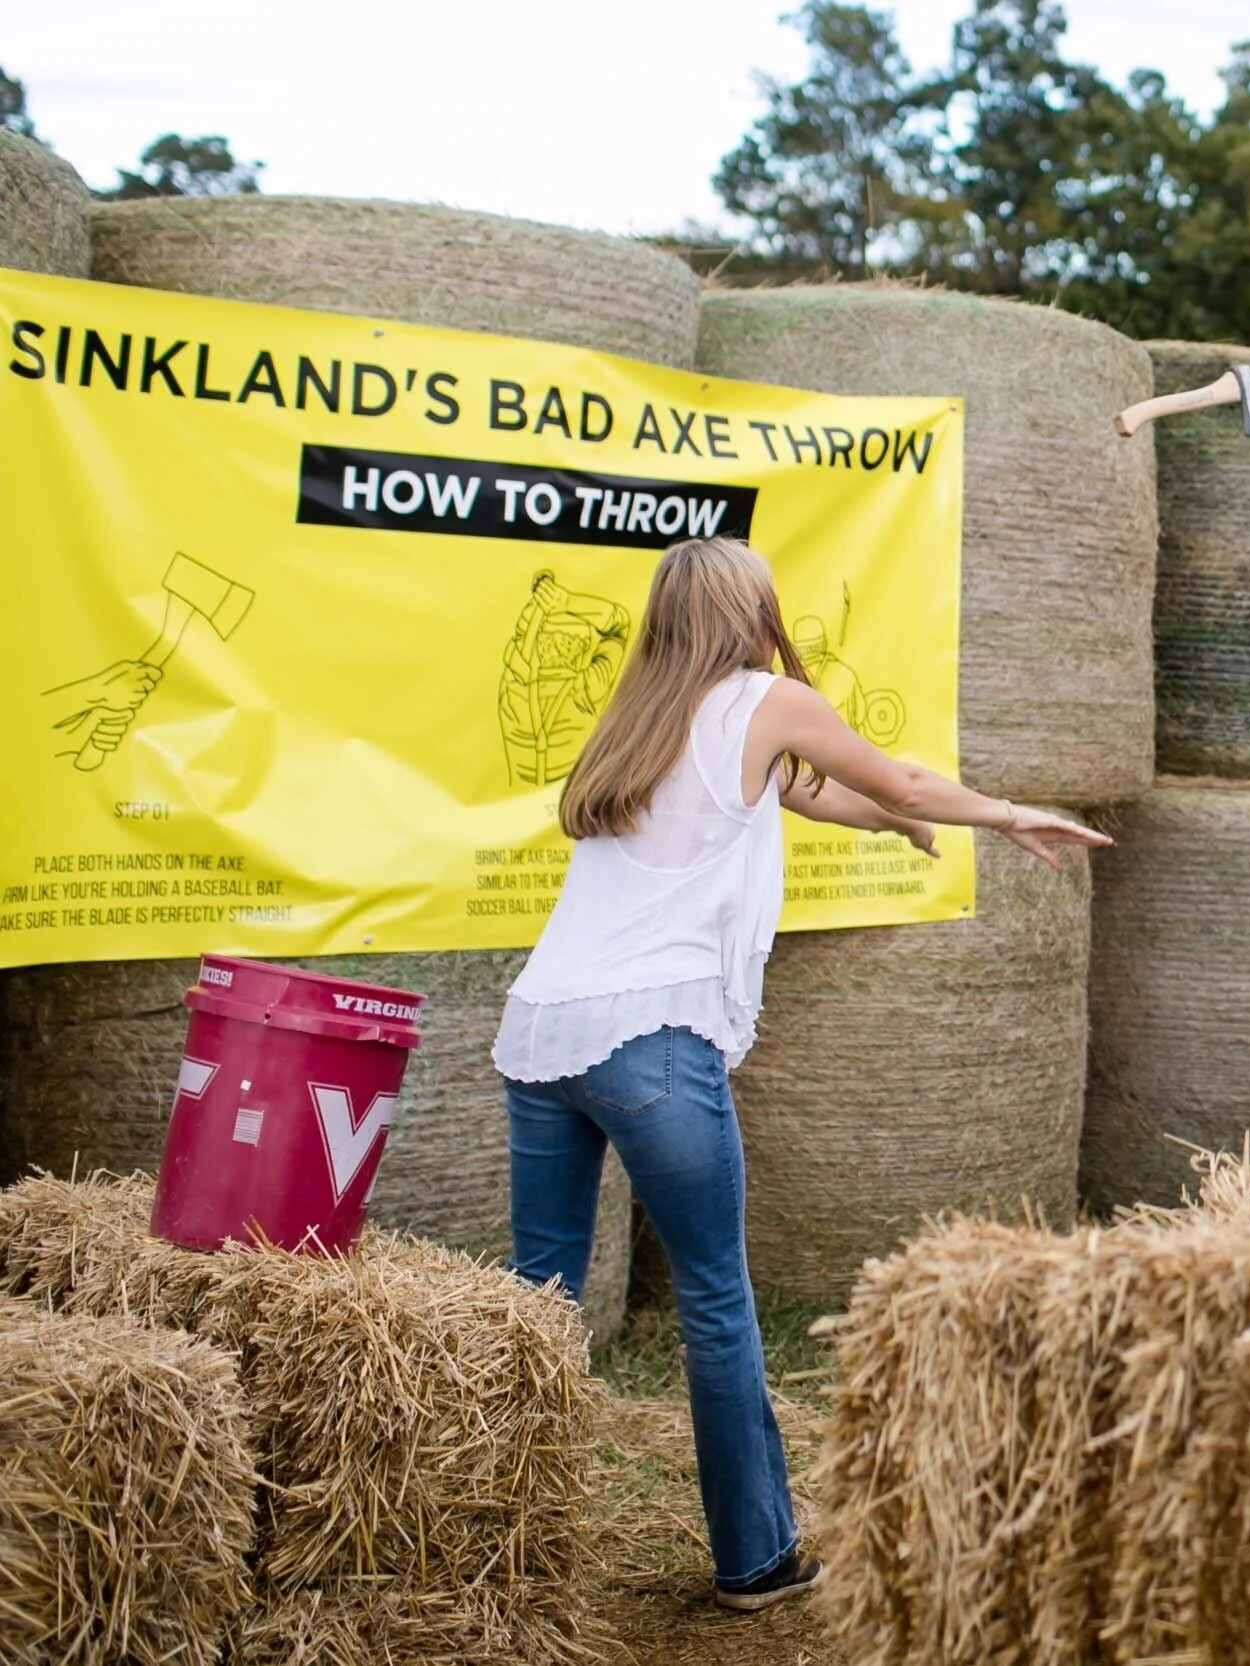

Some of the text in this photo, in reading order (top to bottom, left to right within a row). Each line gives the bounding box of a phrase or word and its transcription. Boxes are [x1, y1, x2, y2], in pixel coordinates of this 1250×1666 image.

[9, 320, 934, 474] SINKLAND'S BAD AXE THROW
[341, 465, 728, 539] HOW TO THROW
[113, 801, 169, 821] STEP 01
[475, 848, 506, 866] BRING
[510, 848, 526, 865] THE
[527, 848, 546, 865] AXE
[791, 842, 815, 857] BRING
[818, 841, 833, 857] THE
[836, 840, 852, 856] AXE
[34, 855, 74, 873] PLACE
[78, 853, 112, 872] BOTH
[116, 853, 162, 871] HANDS
[165, 853, 184, 870] ON
[188, 854, 213, 871] THE
[788, 863, 808, 880] FAST
[811, 862, 842, 879] MOTION
[846, 861, 863, 877] AND
[865, 860, 905, 876] RELEASE
[909, 858, 934, 873] WITH
[31, 882, 59, 901] LIKE
[62, 881, 107, 899] YOU'RE
[111, 880, 167, 898] HOLDING
[171, 880, 180, 896] A
[184, 879, 252, 896] BASEBALL
[477, 873, 517, 891] SIMILAR
[519, 873, 531, 890] TO
[533, 872, 549, 889] THE
[783, 886, 800, 902] OUR
[803, 885, 827, 900] ARMS
[829, 882, 875, 900] EXTENDED
[466, 898, 506, 916] SOCCER
[509, 897, 532, 915] BALL
[0, 912, 22, 933] AKE
[25, 910, 57, 929] SURE
[62, 908, 86, 927] THE
[89, 906, 131, 926] BLADE
[136, 906, 148, 924] IS
[151, 904, 225, 924] PERFECTLY
[332, 993, 424, 1020] VIRGINI
